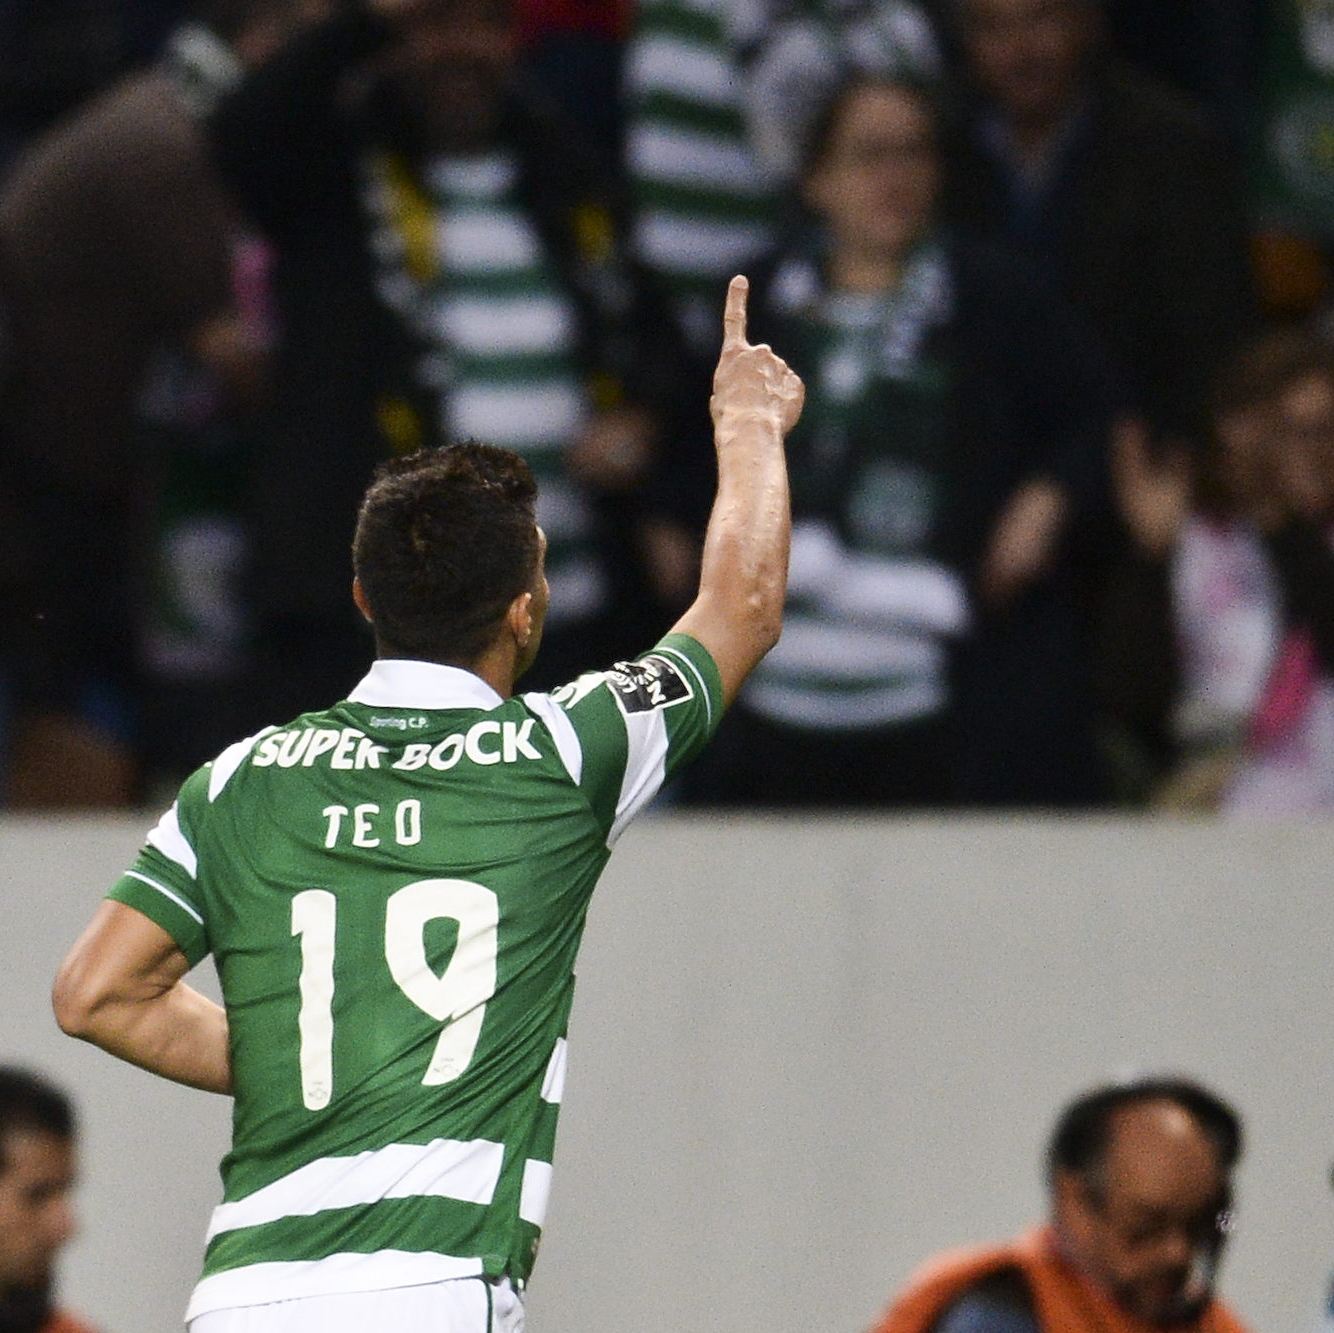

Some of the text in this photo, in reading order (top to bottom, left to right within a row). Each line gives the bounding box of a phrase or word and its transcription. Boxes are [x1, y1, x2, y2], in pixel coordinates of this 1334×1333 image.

[252, 719, 542, 770] SUPER BOCK
[322, 799, 421, 848] TEO
[291, 878, 498, 1110] 19
